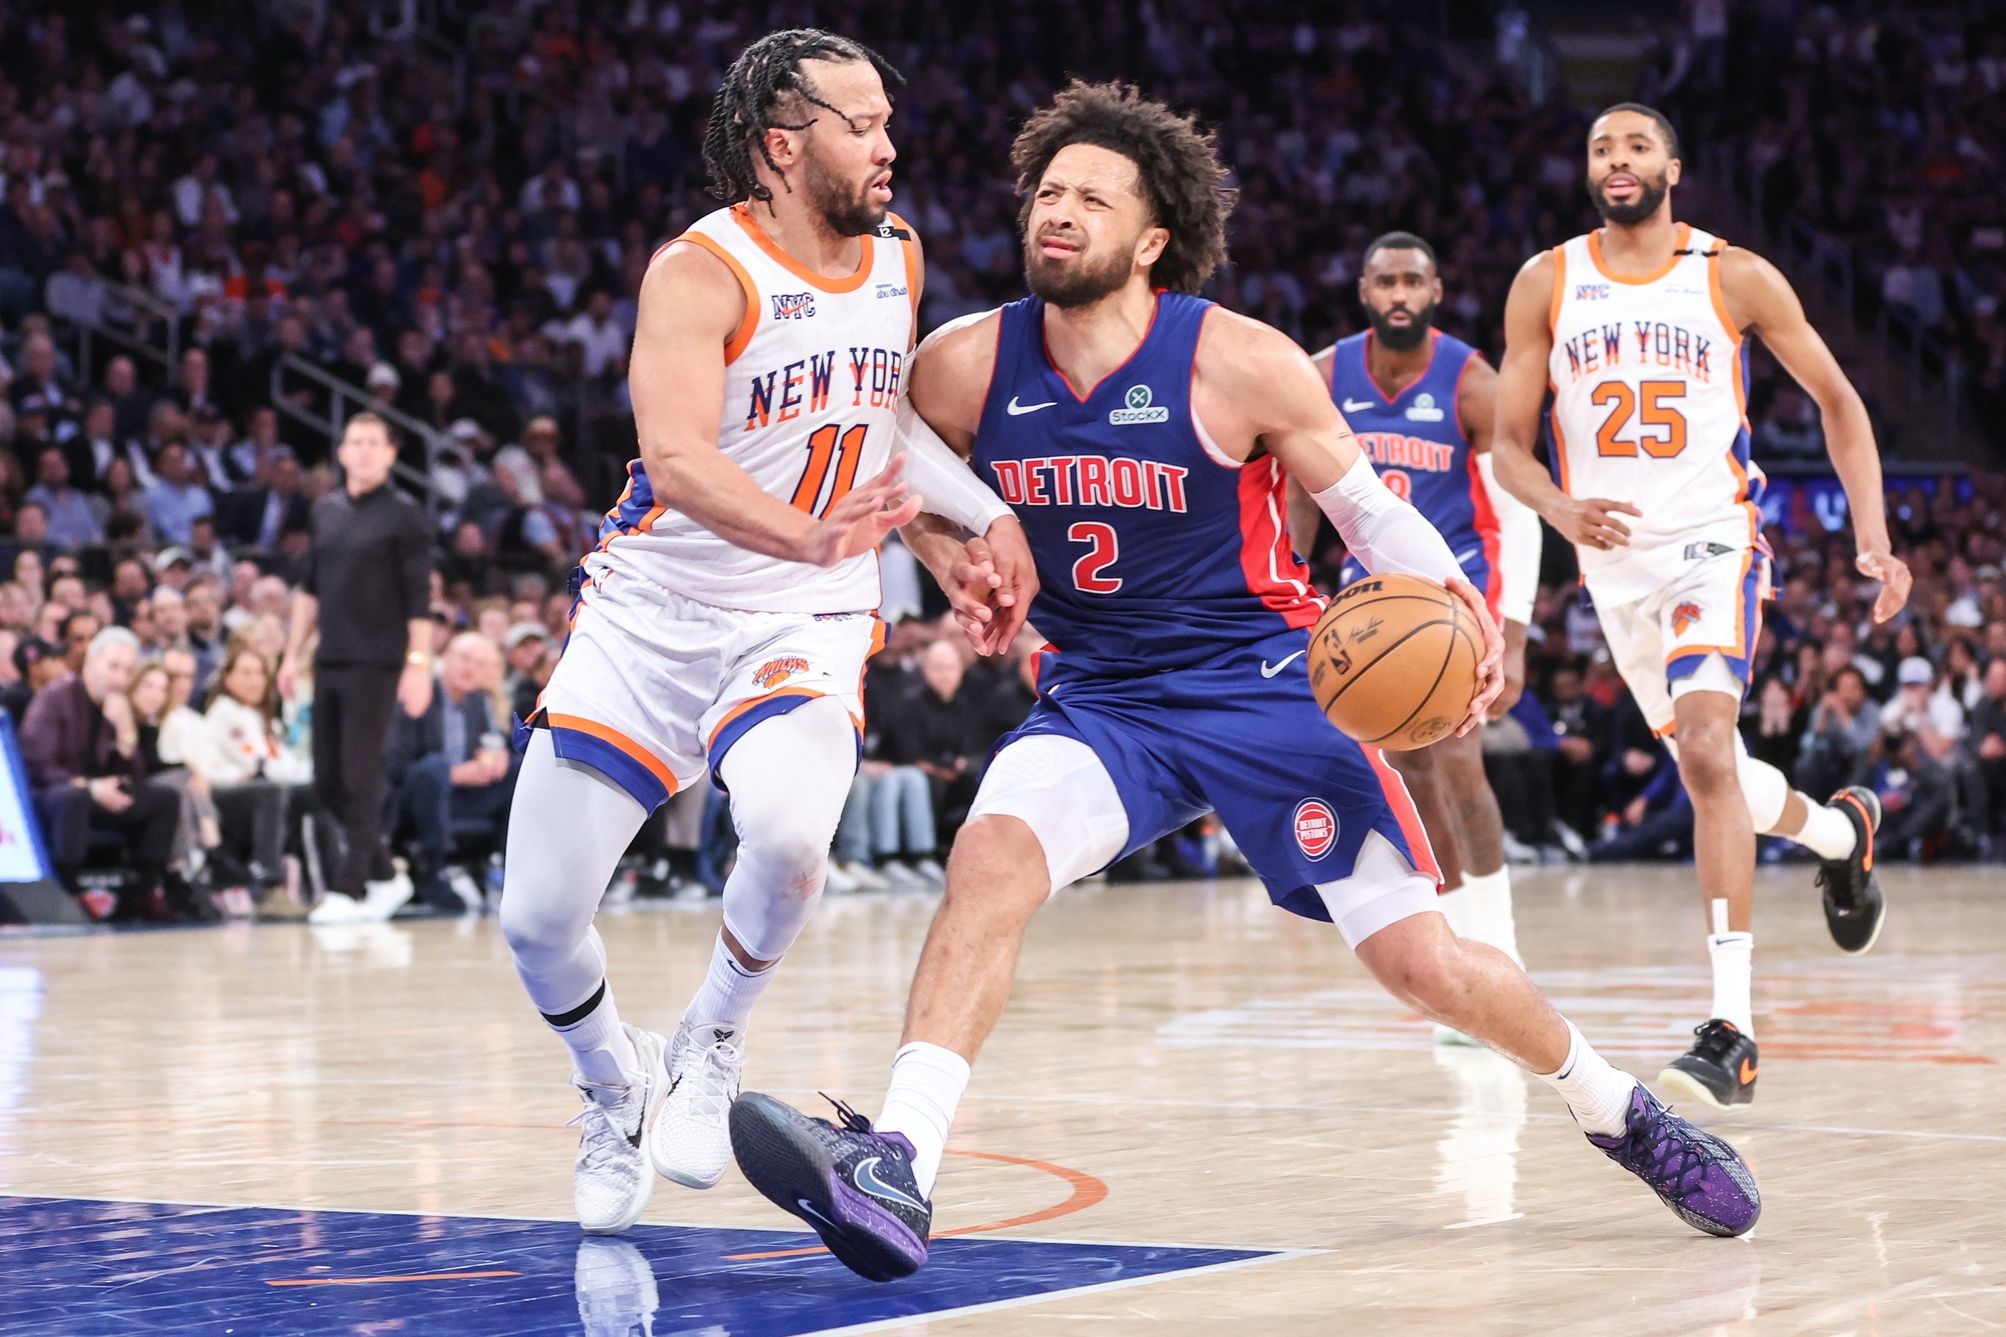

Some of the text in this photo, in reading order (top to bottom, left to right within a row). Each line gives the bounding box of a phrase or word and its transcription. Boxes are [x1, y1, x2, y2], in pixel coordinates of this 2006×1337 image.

[772, 292, 816, 320] NYC
[1565, 321, 1711, 383] NEW YORK
[744, 347, 902, 431] NEW YOR
[1112, 409, 1167, 422] StockX
[1591, 380, 1687, 458] 25
[790, 423, 869, 521] 11
[1355, 432, 1455, 473] ETROIT
[991, 455, 1189, 513] DETROIT
[1068, 521, 1123, 594] 2
